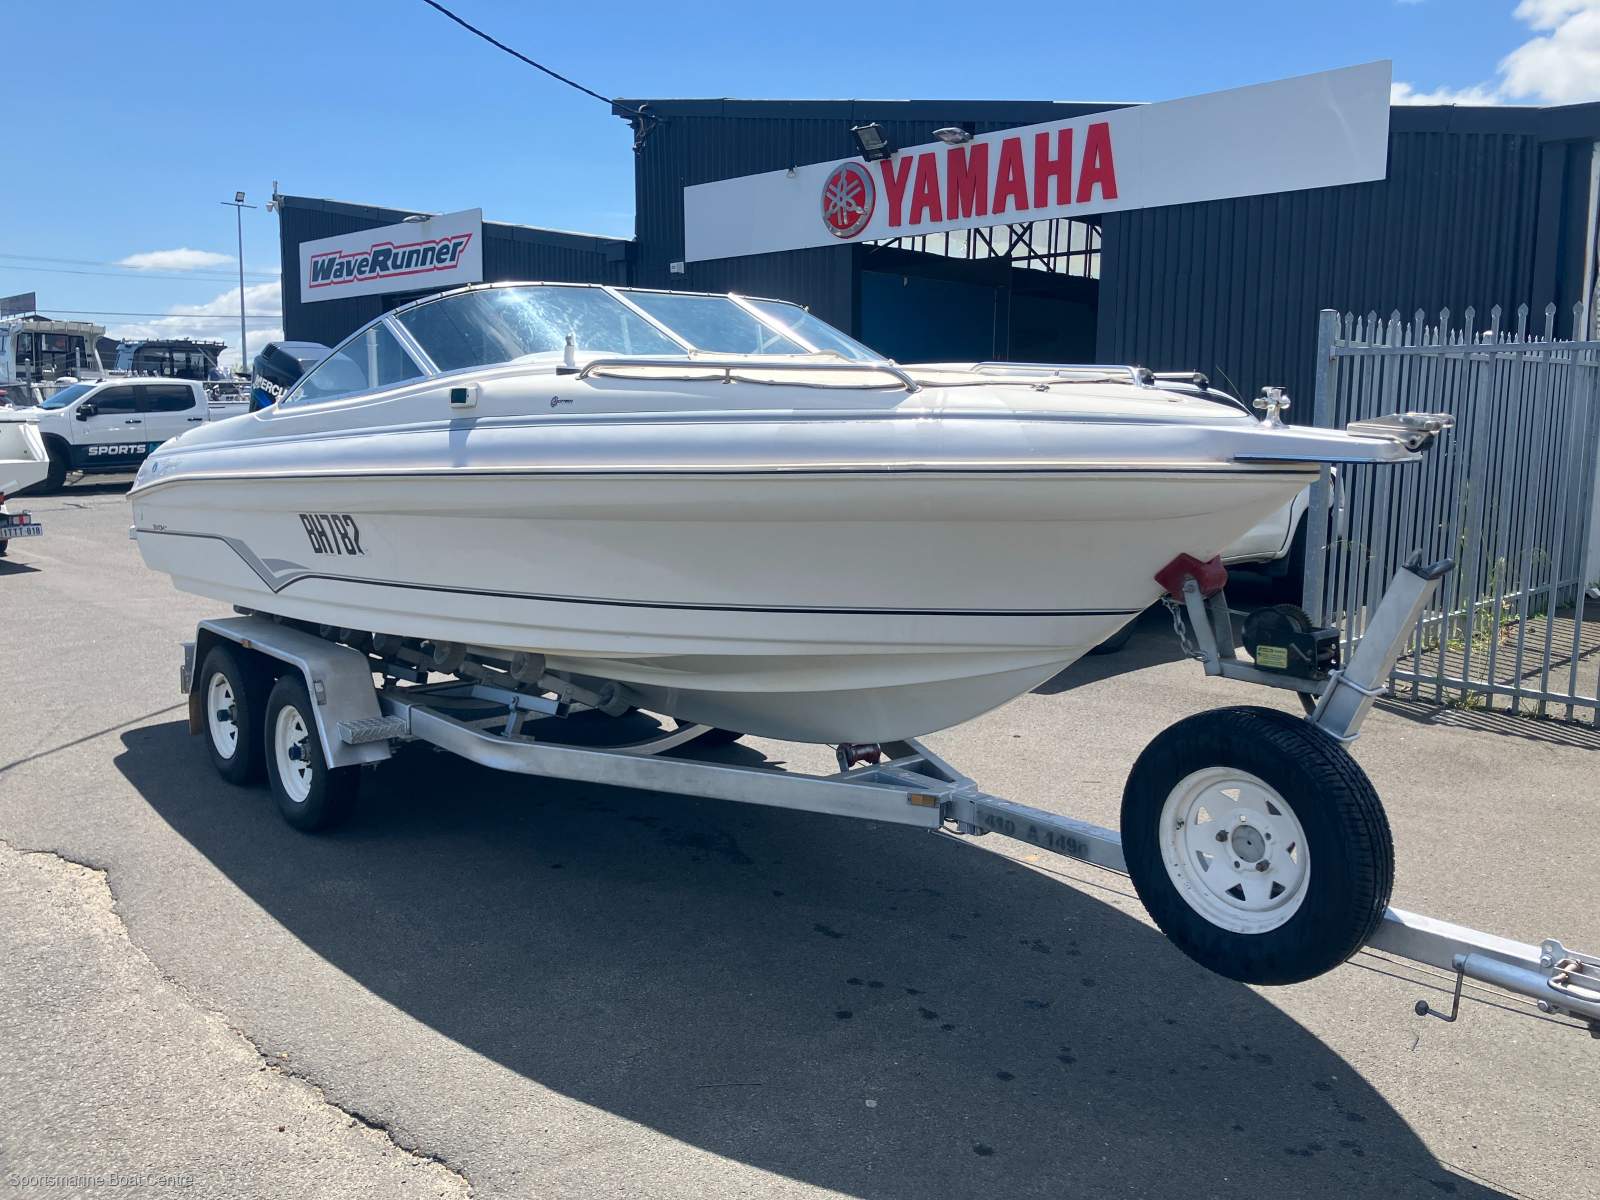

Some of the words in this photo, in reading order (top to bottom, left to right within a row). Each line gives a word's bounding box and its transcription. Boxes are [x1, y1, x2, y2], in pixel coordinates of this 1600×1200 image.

[880, 122, 1118, 227] YAMAHA
[311, 240, 465, 283] WaveRunner
[253, 374, 288, 398] MERCU
[88, 444, 146, 456] SPORTS
[298, 513, 366, 555] BH782
